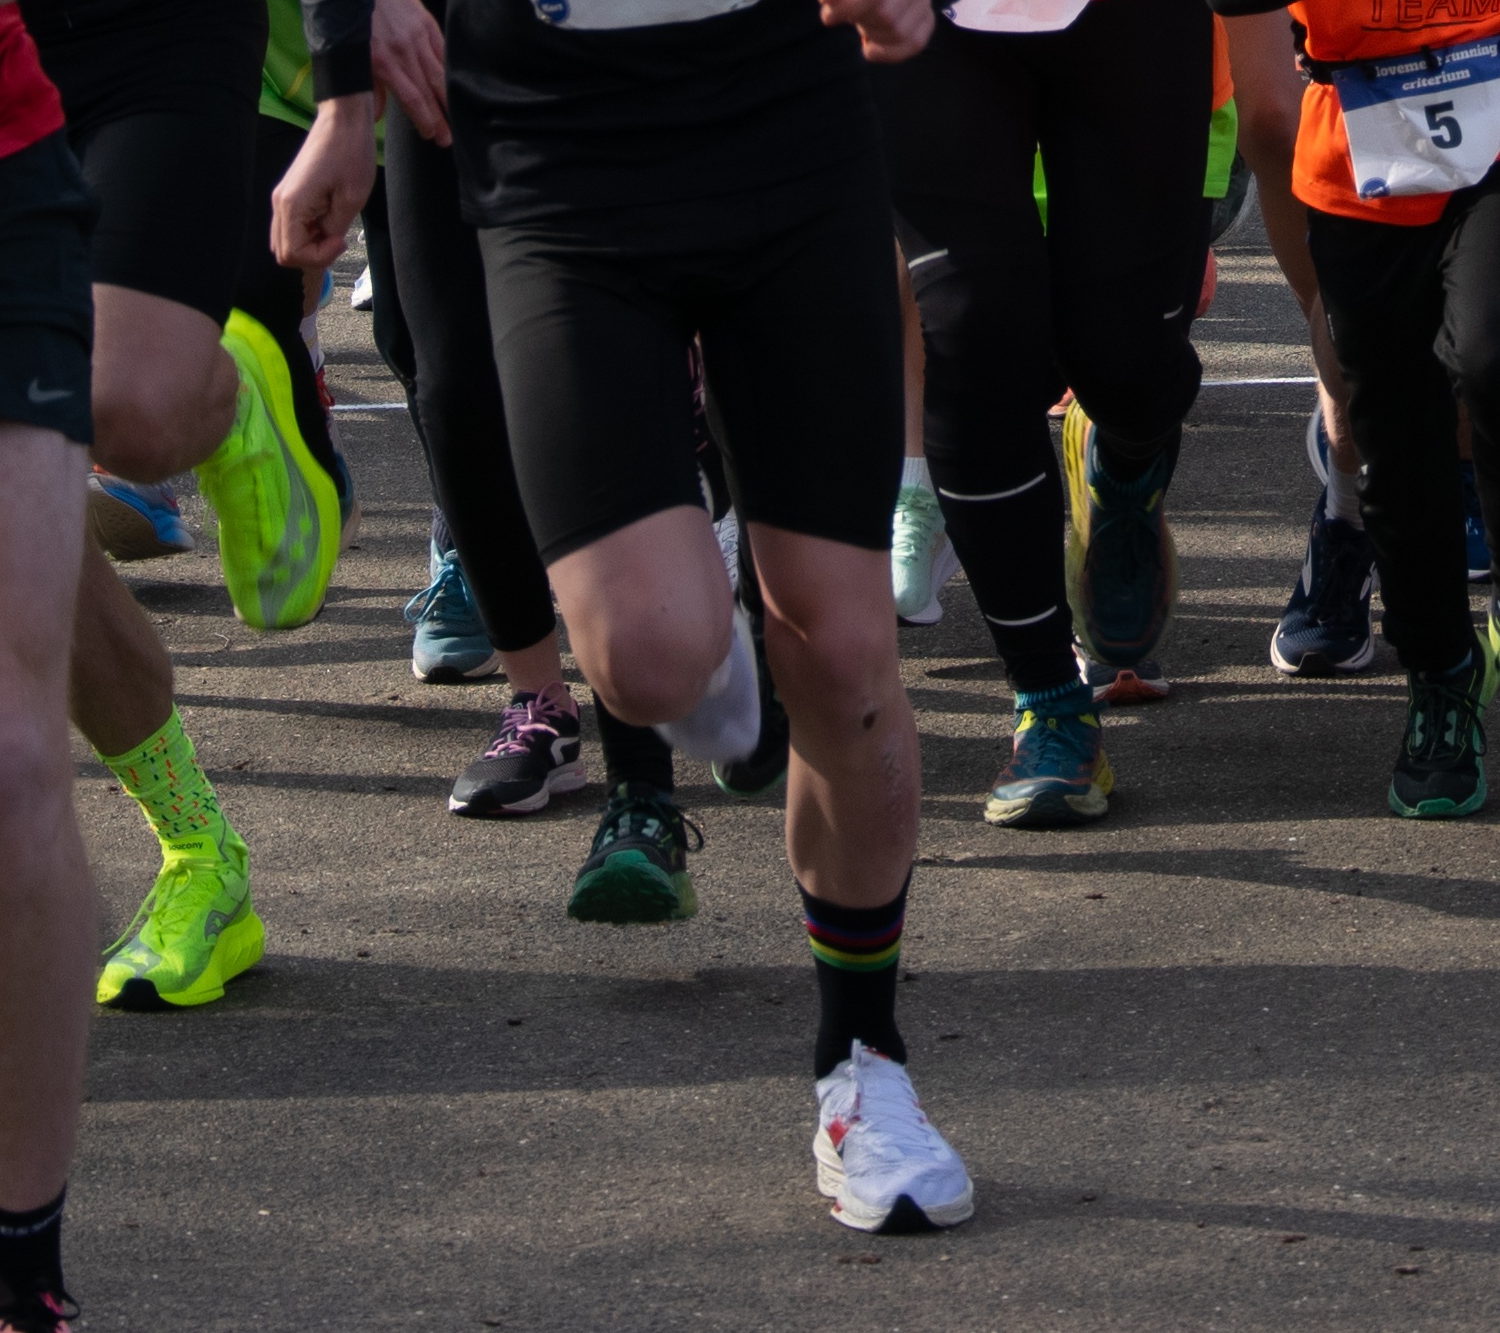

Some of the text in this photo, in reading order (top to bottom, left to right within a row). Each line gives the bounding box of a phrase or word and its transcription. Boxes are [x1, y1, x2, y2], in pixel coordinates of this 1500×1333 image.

[1375, 42, 1498, 78] ovemet running
[1402, 68, 1471, 91] criterium
[1424, 100, 1463, 150] 5
